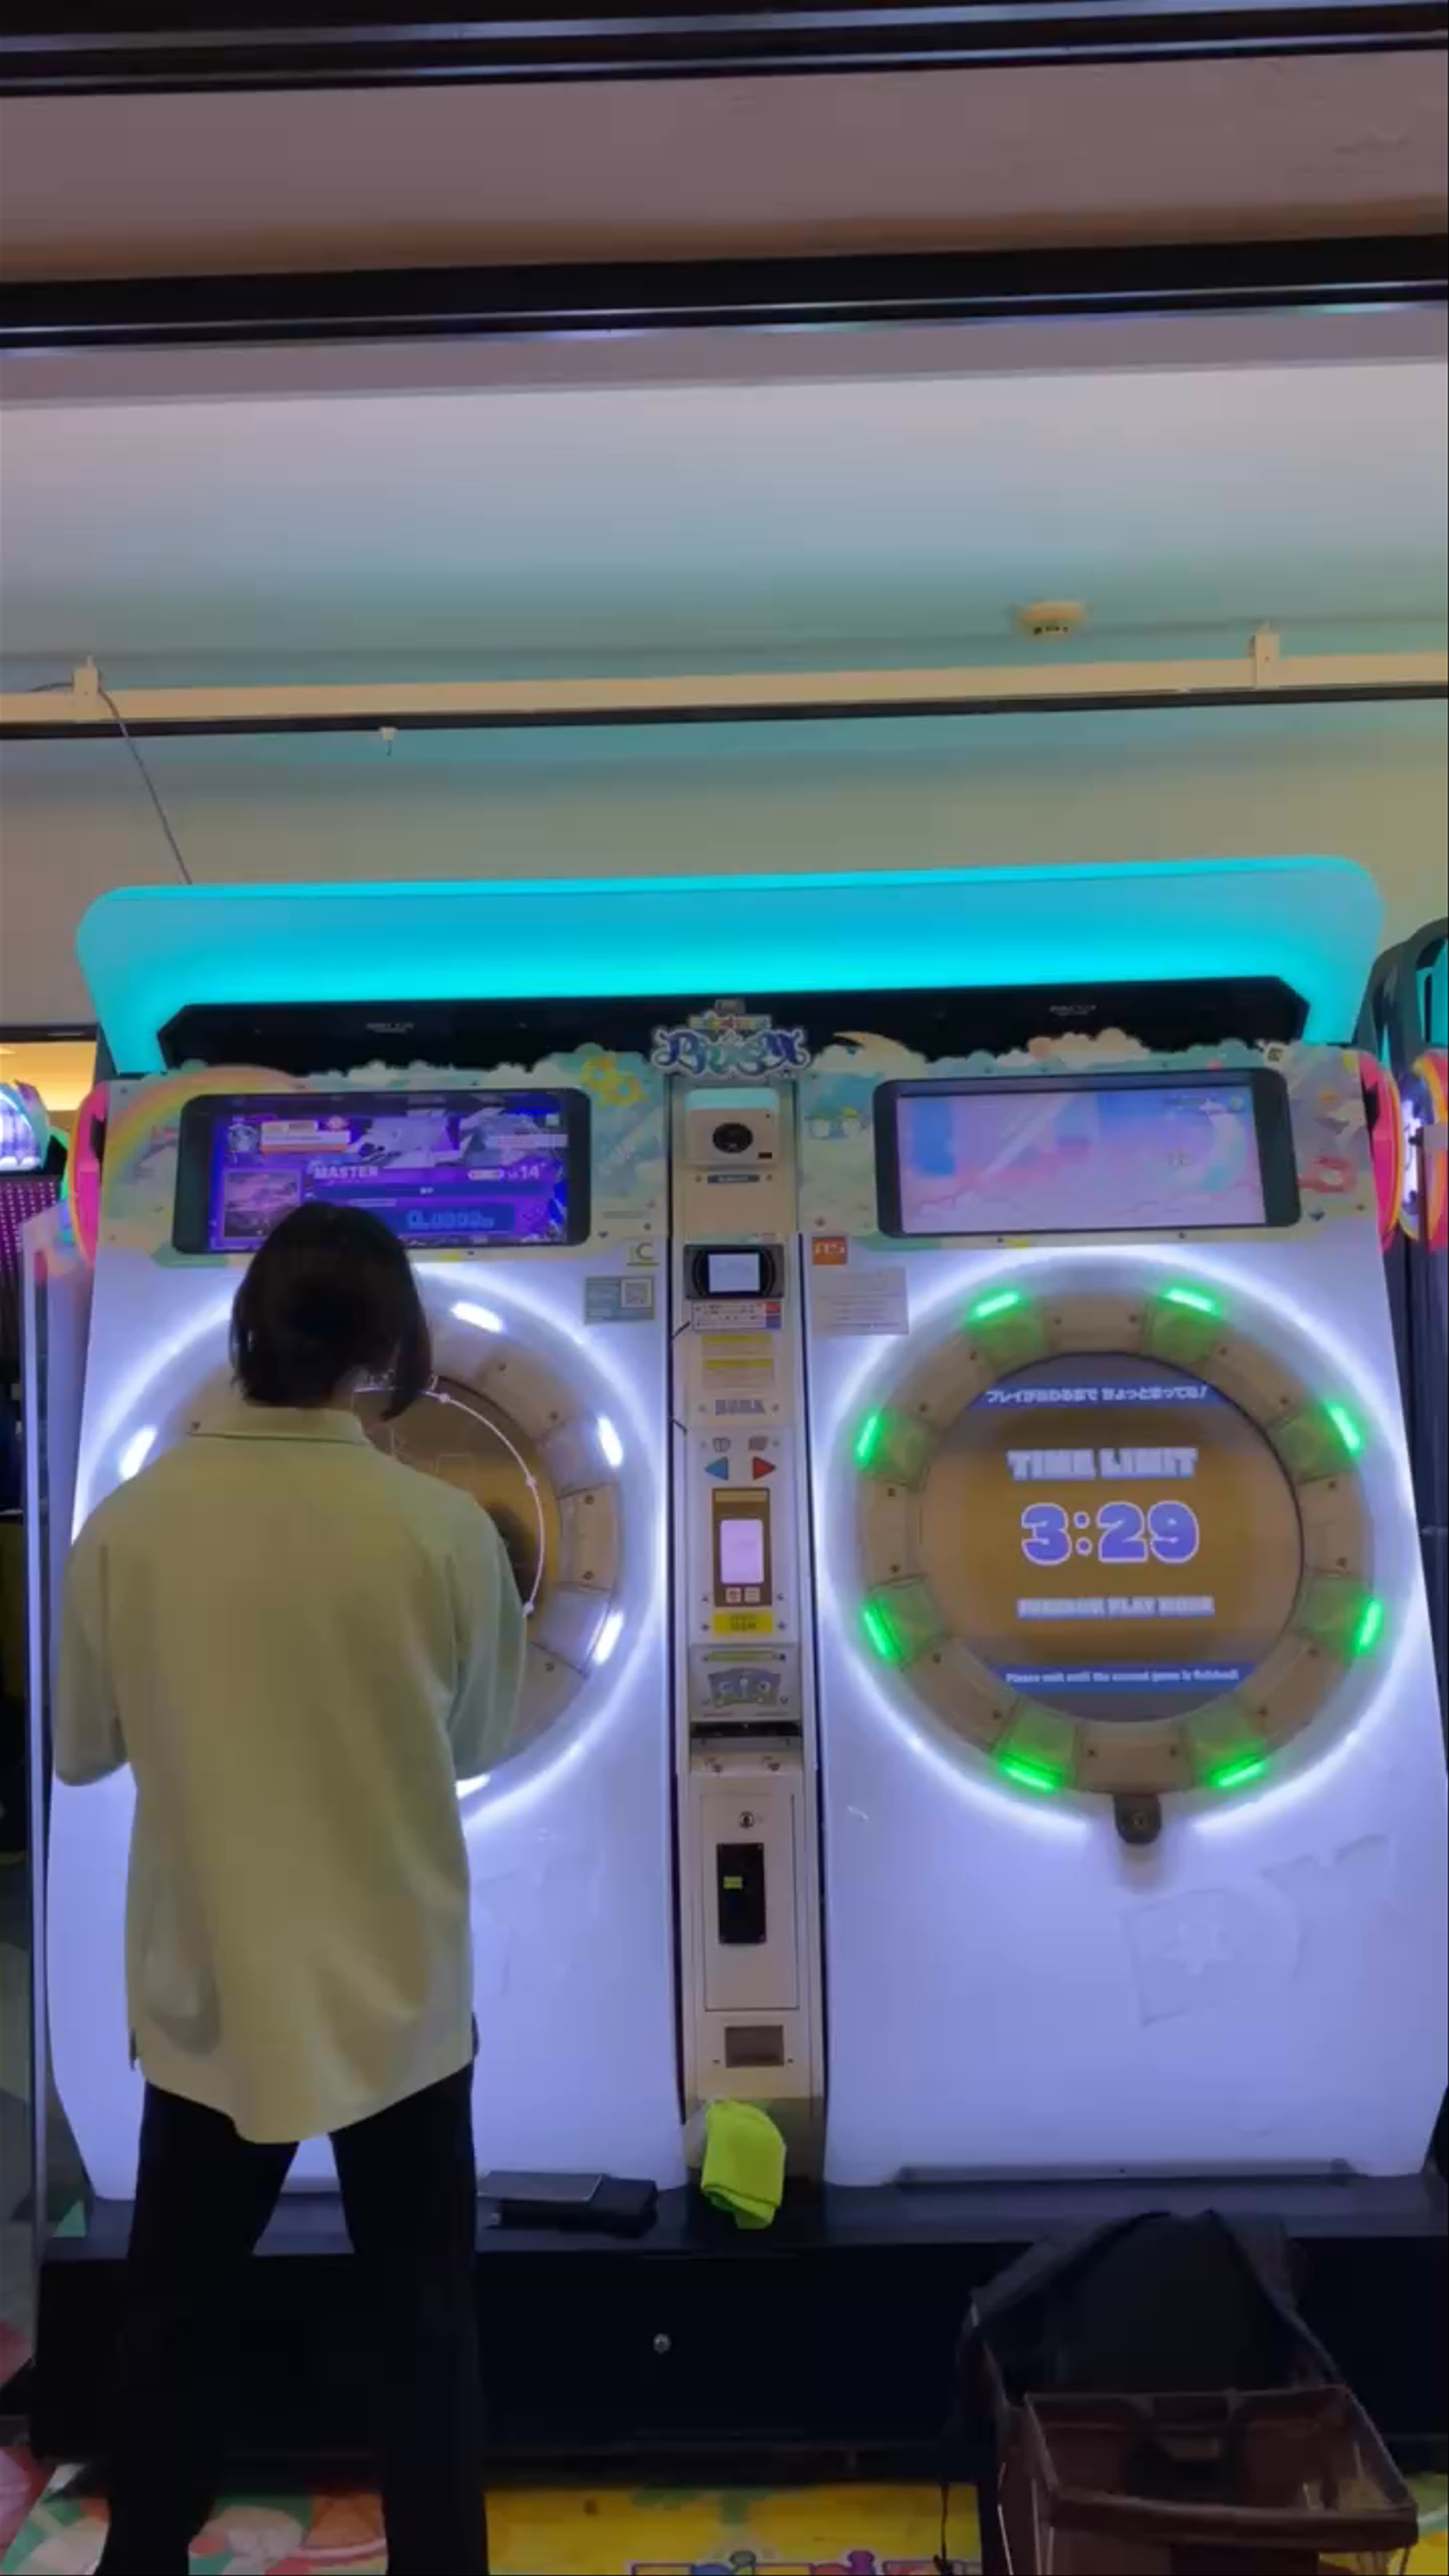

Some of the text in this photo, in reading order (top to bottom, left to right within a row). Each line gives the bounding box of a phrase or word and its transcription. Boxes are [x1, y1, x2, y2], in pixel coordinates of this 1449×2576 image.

[314, 1166, 378, 1179] MASTER
[1006, 1447, 1198, 1480] TIME LIMIT
[1021, 1500, 1199, 1565] 3:29
[1006, 1673, 1040, 1683] Please
[1093, 1672, 1109, 1682] the
